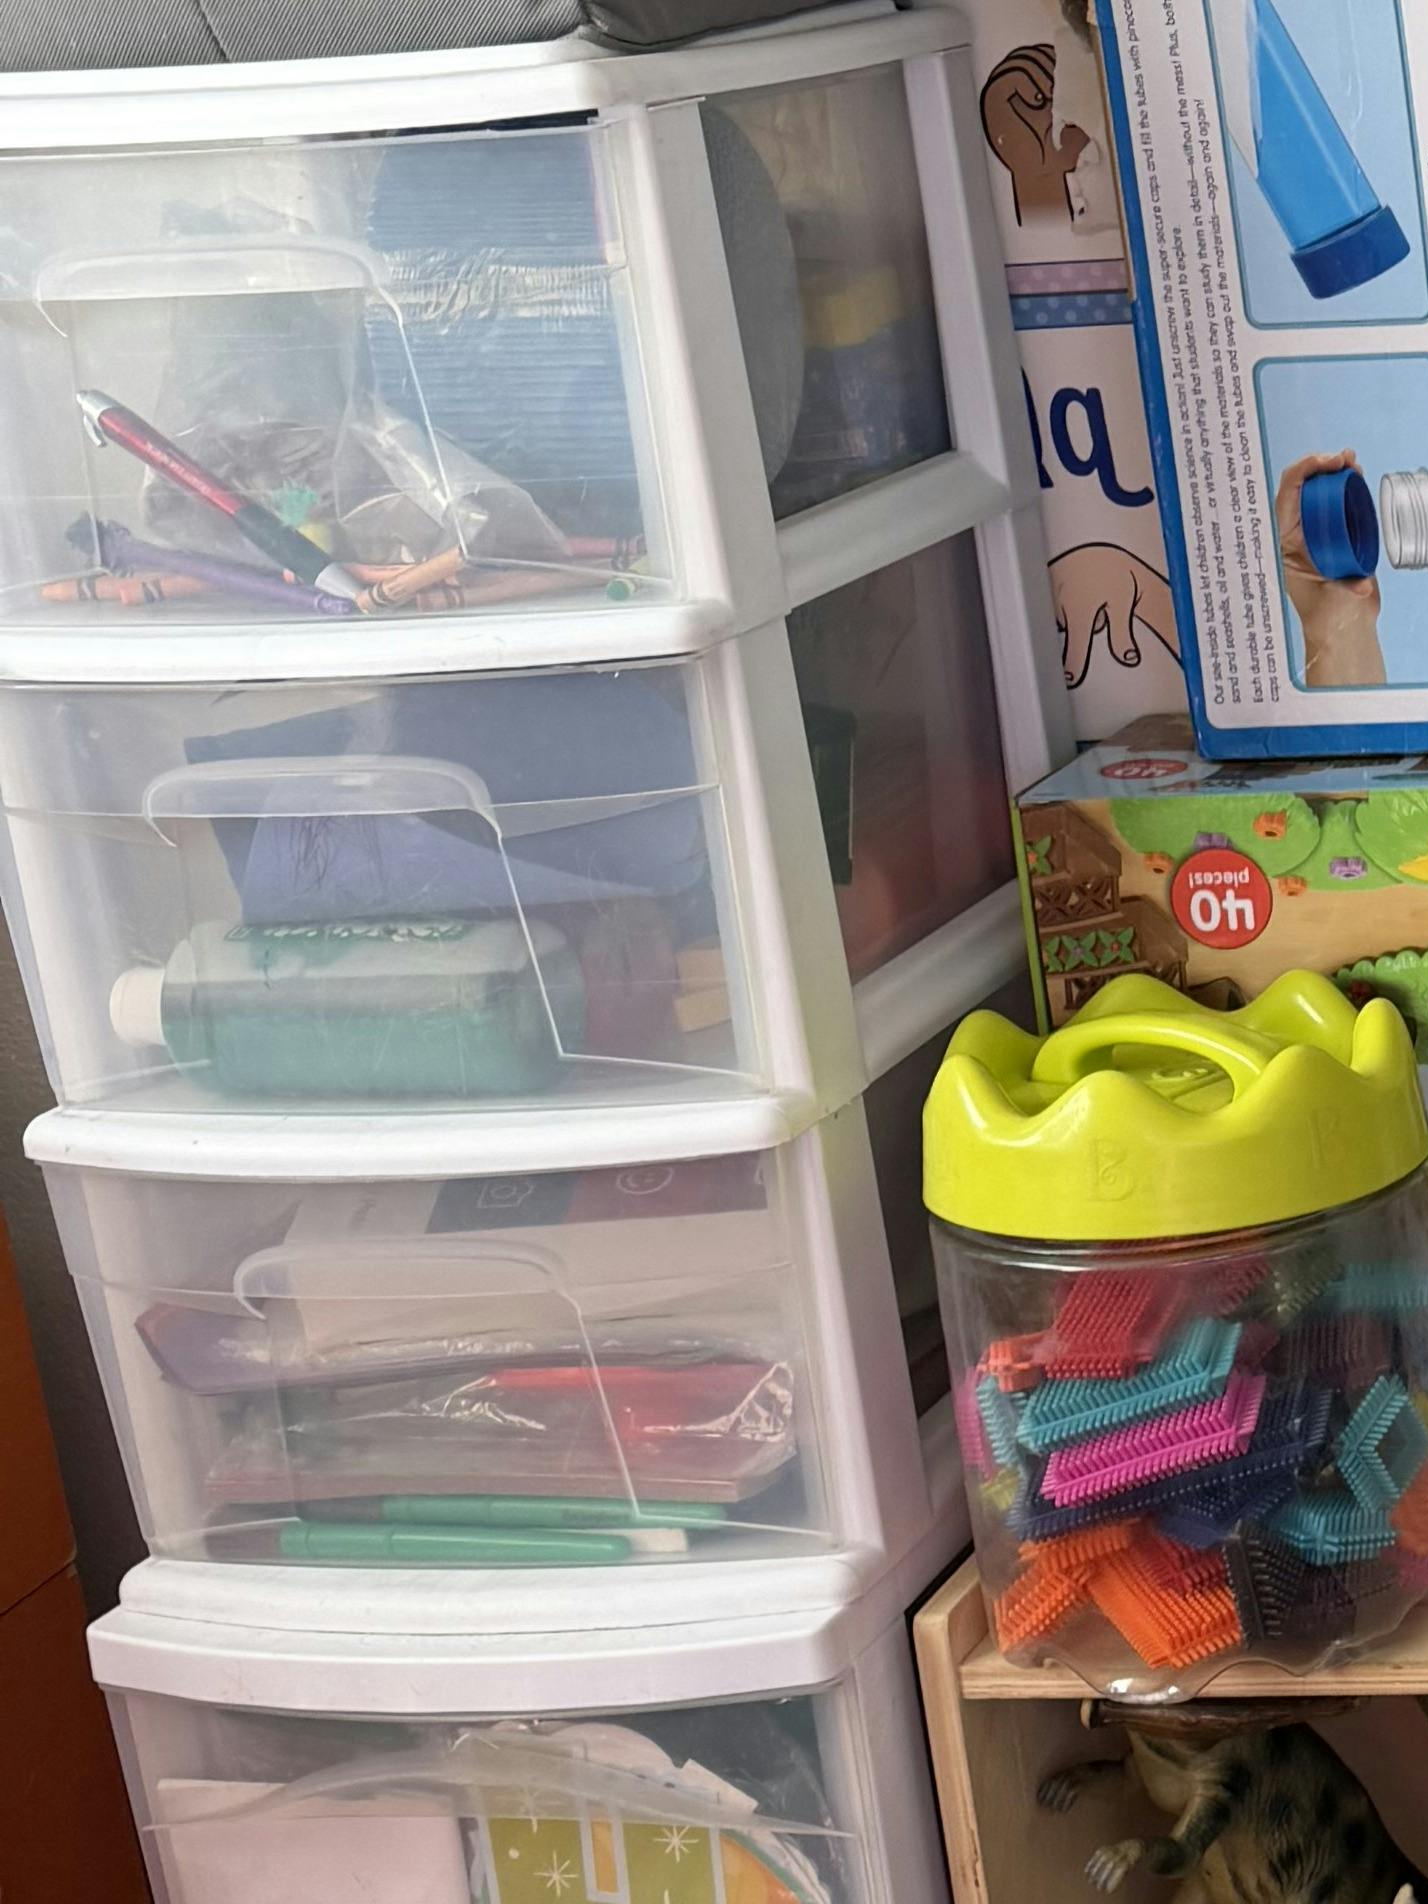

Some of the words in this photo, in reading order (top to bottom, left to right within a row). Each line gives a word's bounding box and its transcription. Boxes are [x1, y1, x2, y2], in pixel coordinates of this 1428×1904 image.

[1127, 44, 1141, 71] with
[1134, 73, 1147, 107] tubes
[1138, 109, 1149, 128] the
[1177, 98, 1188, 117] the
[1139, 132, 1151, 145] fill
[1197, 139, 1211, 163] and
[1141, 148, 1155, 171] and
[1148, 174, 1160, 203] caps
[1192, 215, 1203, 226] in
[1195, 228, 1207, 259] them
[1178, 273, 1187, 285] to
[1198, 262, 1213, 294] study
[1216, 271, 1228, 290] the
[1162, 283, 1173, 303] the
[1179, 288, 1191, 317] want
[1219, 293, 1231, 312] out
[1205, 297, 1215, 318] can
[1167, 306, 1180, 354] unscrew
[1208, 320, 1219, 346] they
[1223, 314, 1235, 347] swap
[1183, 319, 1199, 369] students
[1211, 348, 1221, 362] so
[1171, 357, 1184, 380] Just
[1226, 349, 1239, 372] and
[1189, 372, 1201, 395] that
[1211, 364, 1228, 417] materials
[1231, 374, 1243, 407] tubes
[1180, 424, 1191, 434] in
[1194, 398, 1209, 448] anything
[1220, 420, 1231, 439] the
[1234, 409, 1245, 428] the
[1183, 437, 1197, 479] science
[1220, 441, 1233, 454] of
[1238, 431, 1250, 461] clean
[1199, 450, 1215, 493] virtually
[1226, 455, 1236, 482] view
[1242, 464, 1251, 475] to
[1189, 481, 1203, 526] observe
[1208, 496, 1217, 508] or
[1229, 484, 1241, 512] clear
[1246, 478, 1256, 504] easy
[1233, 514, 1242, 522] a
[1195, 528, 1209, 572] children
[1233, 525, 1248, 569] children
[1212, 555, 1226, 578] and
[1199, 575, 1210, 589] let
[1215, 580, 1227, 594] oil
[1240, 571, 1254, 601] gives
[1202, 591, 1215, 623] tubes
[1242, 602, 1254, 629] tube
[1245, 631, 1260, 674] durable
[1263, 635, 1274, 650] be
[1224, 651, 1237, 674] and
[1266, 652, 1276, 673] can
[1213, 683, 1224, 704] Our
[1227, 676, 1241, 704] sand
[1250, 676, 1263, 703] Each
[1268, 675, 1280, 702] caps
[1187, 865, 1250, 889] pieces!
[1188, 887, 1255, 932] 40
